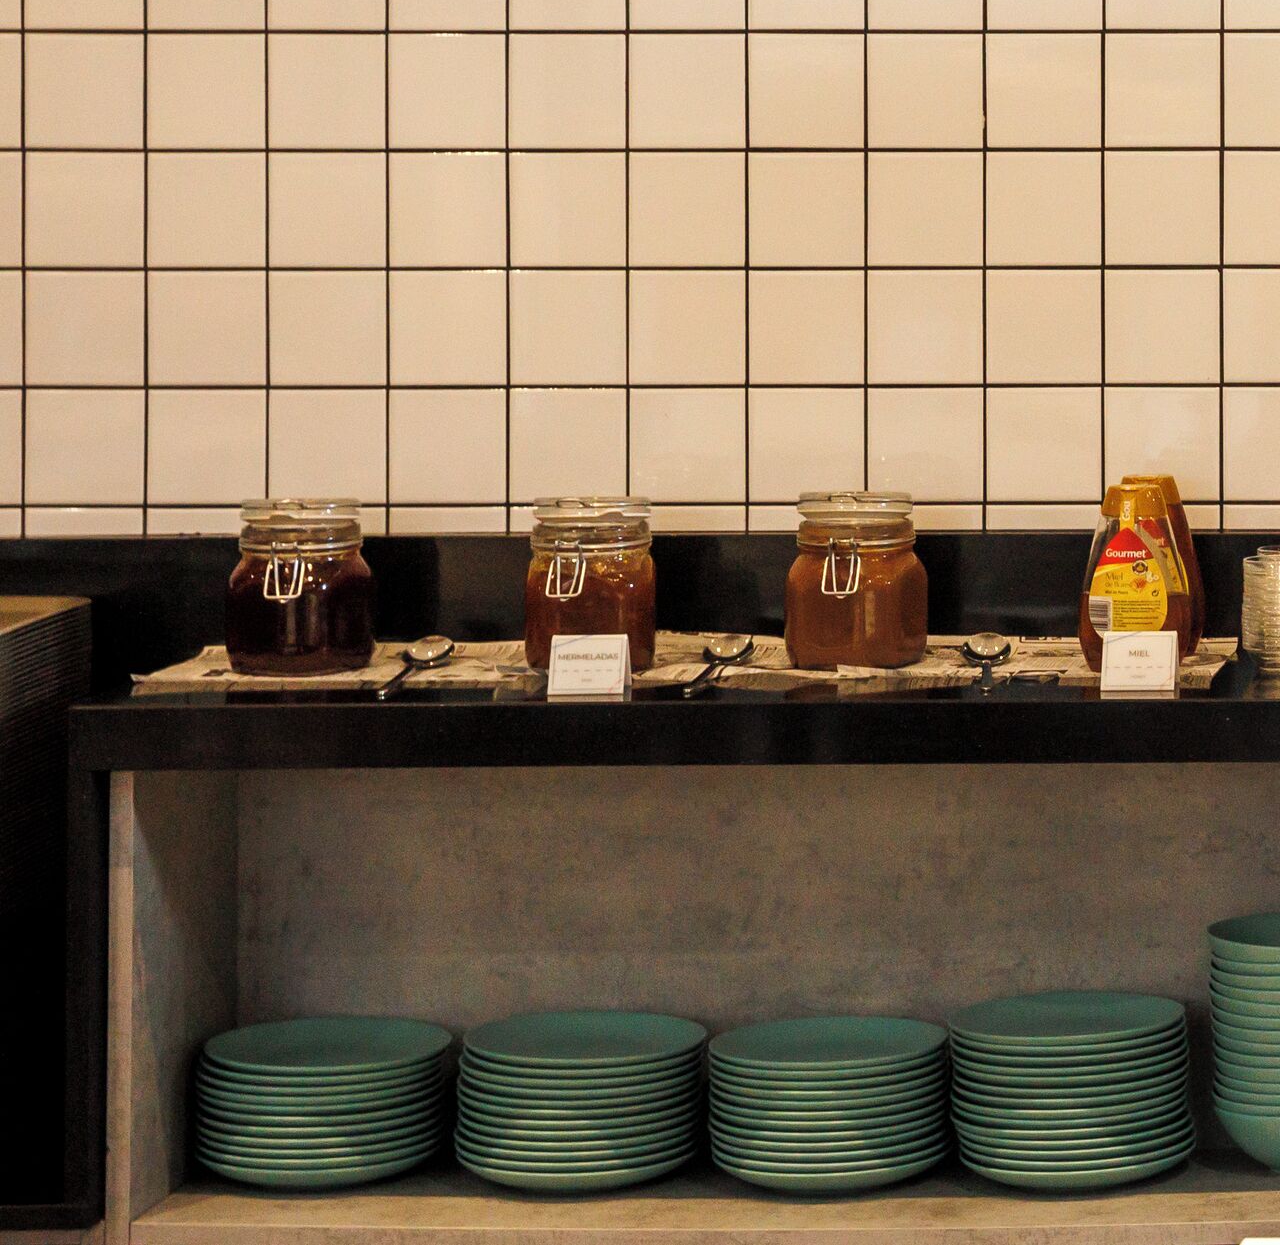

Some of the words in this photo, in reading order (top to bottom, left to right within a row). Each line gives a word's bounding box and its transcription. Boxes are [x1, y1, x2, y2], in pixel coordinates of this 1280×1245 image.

[1105, 547, 1147, 559] Gourmet
[557, 652, 619, 661] MERMELADAS
[1128, 649, 1151, 658] MIEL
